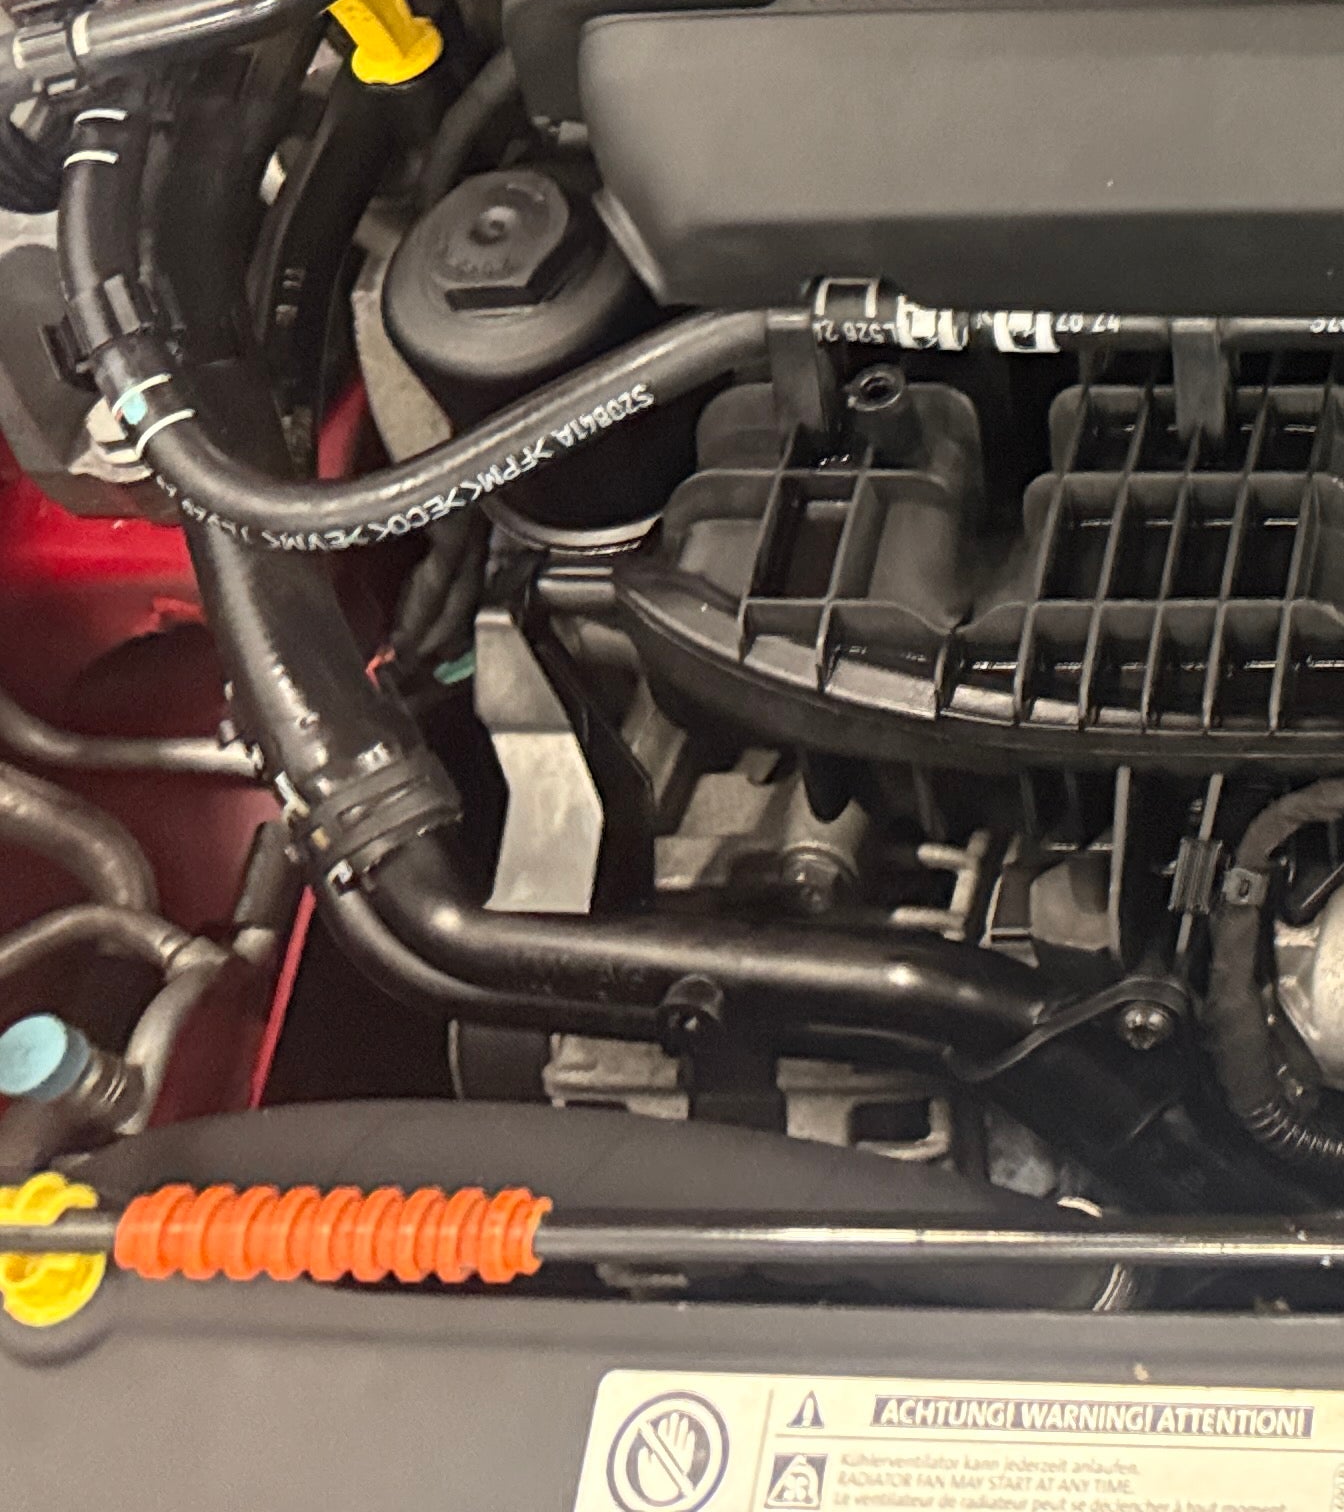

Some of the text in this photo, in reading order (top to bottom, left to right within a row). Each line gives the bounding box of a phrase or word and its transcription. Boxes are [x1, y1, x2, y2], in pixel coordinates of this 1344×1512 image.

[881, 1398, 1304, 1437] ACHTUNG! WARNING! ATTENTION!
[837, 1470, 913, 1488] RADIATOR
[916, 1473, 946, 1489] FAN
[950, 1474, 984, 1490] MAY
[987, 1475, 1031, 1491] START
[1034, 1476, 1054, 1492] AT
[1057, 1477, 1091, 1493] ANY
